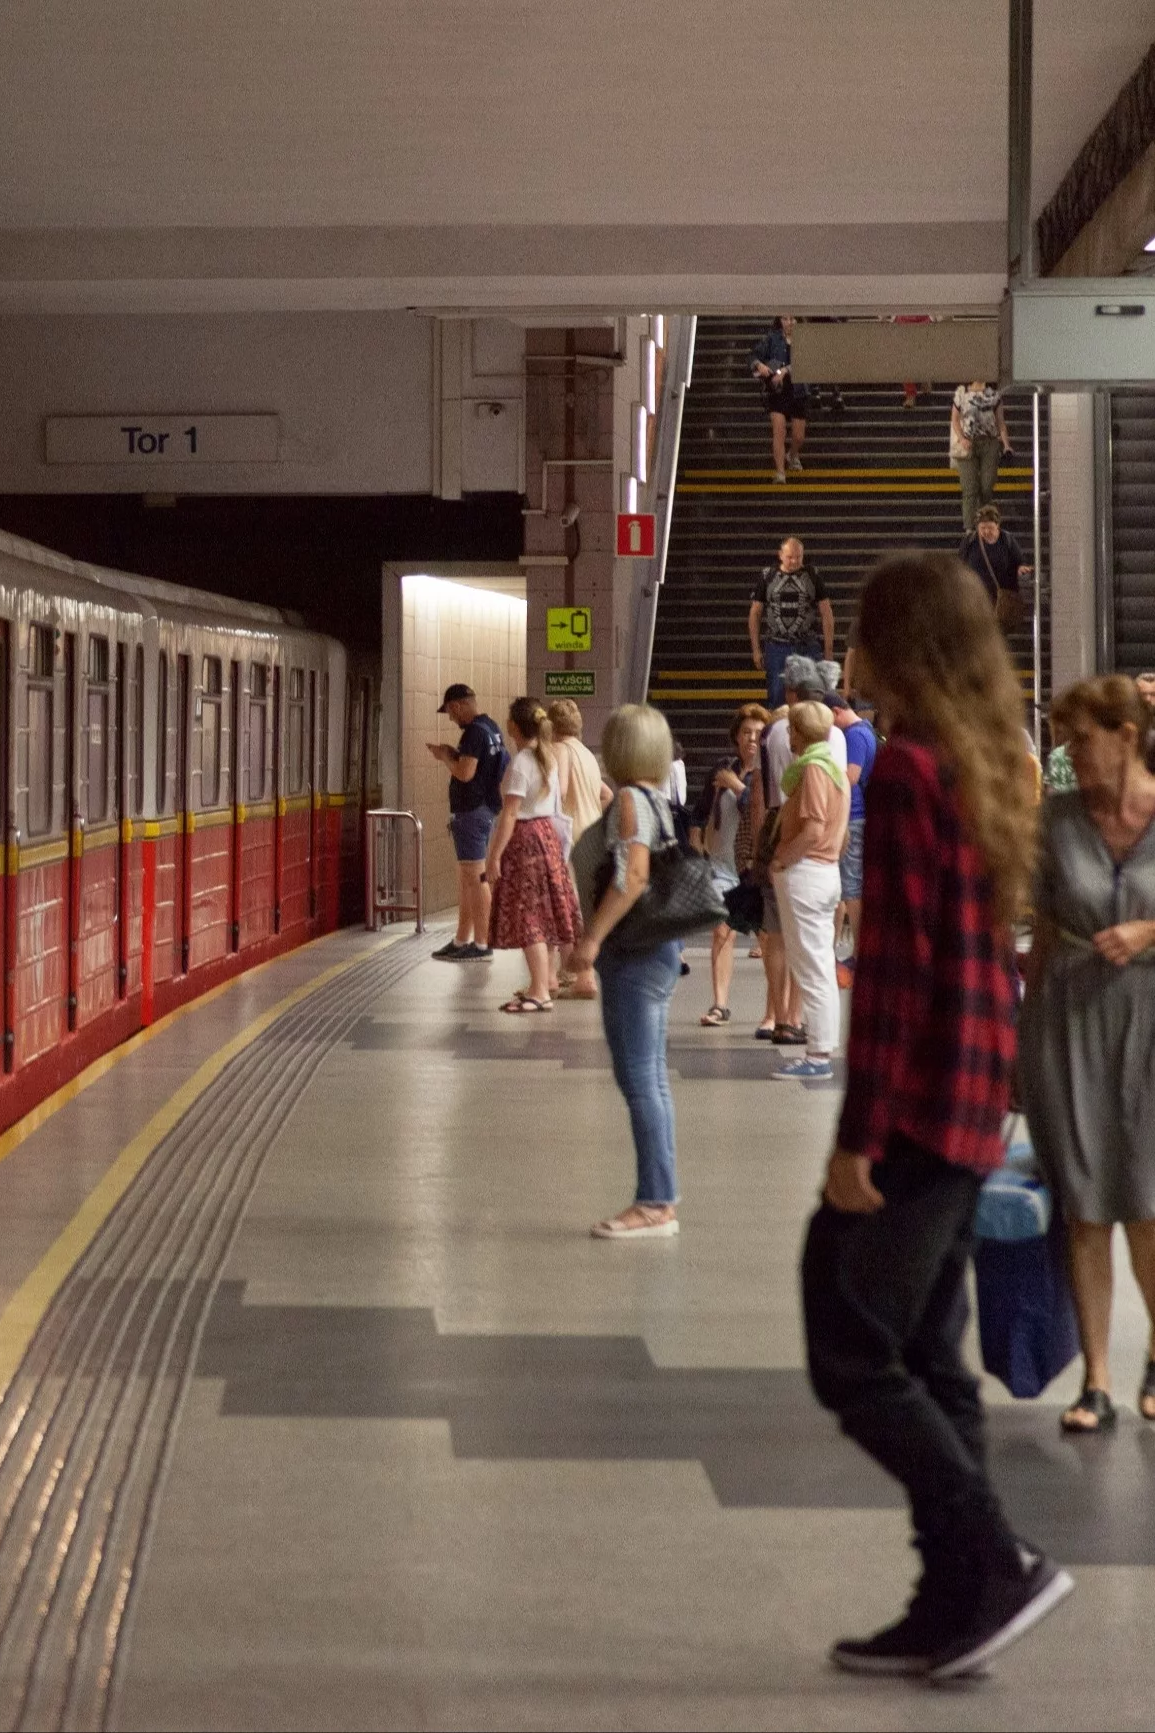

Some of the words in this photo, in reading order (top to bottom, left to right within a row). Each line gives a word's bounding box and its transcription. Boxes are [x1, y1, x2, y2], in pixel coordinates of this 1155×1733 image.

[121, 426, 170, 453] Tor
[184, 426, 198, 453] 1
[555, 641, 584, 649] winda
[548, 674, 593, 685] WYJŚCIE
